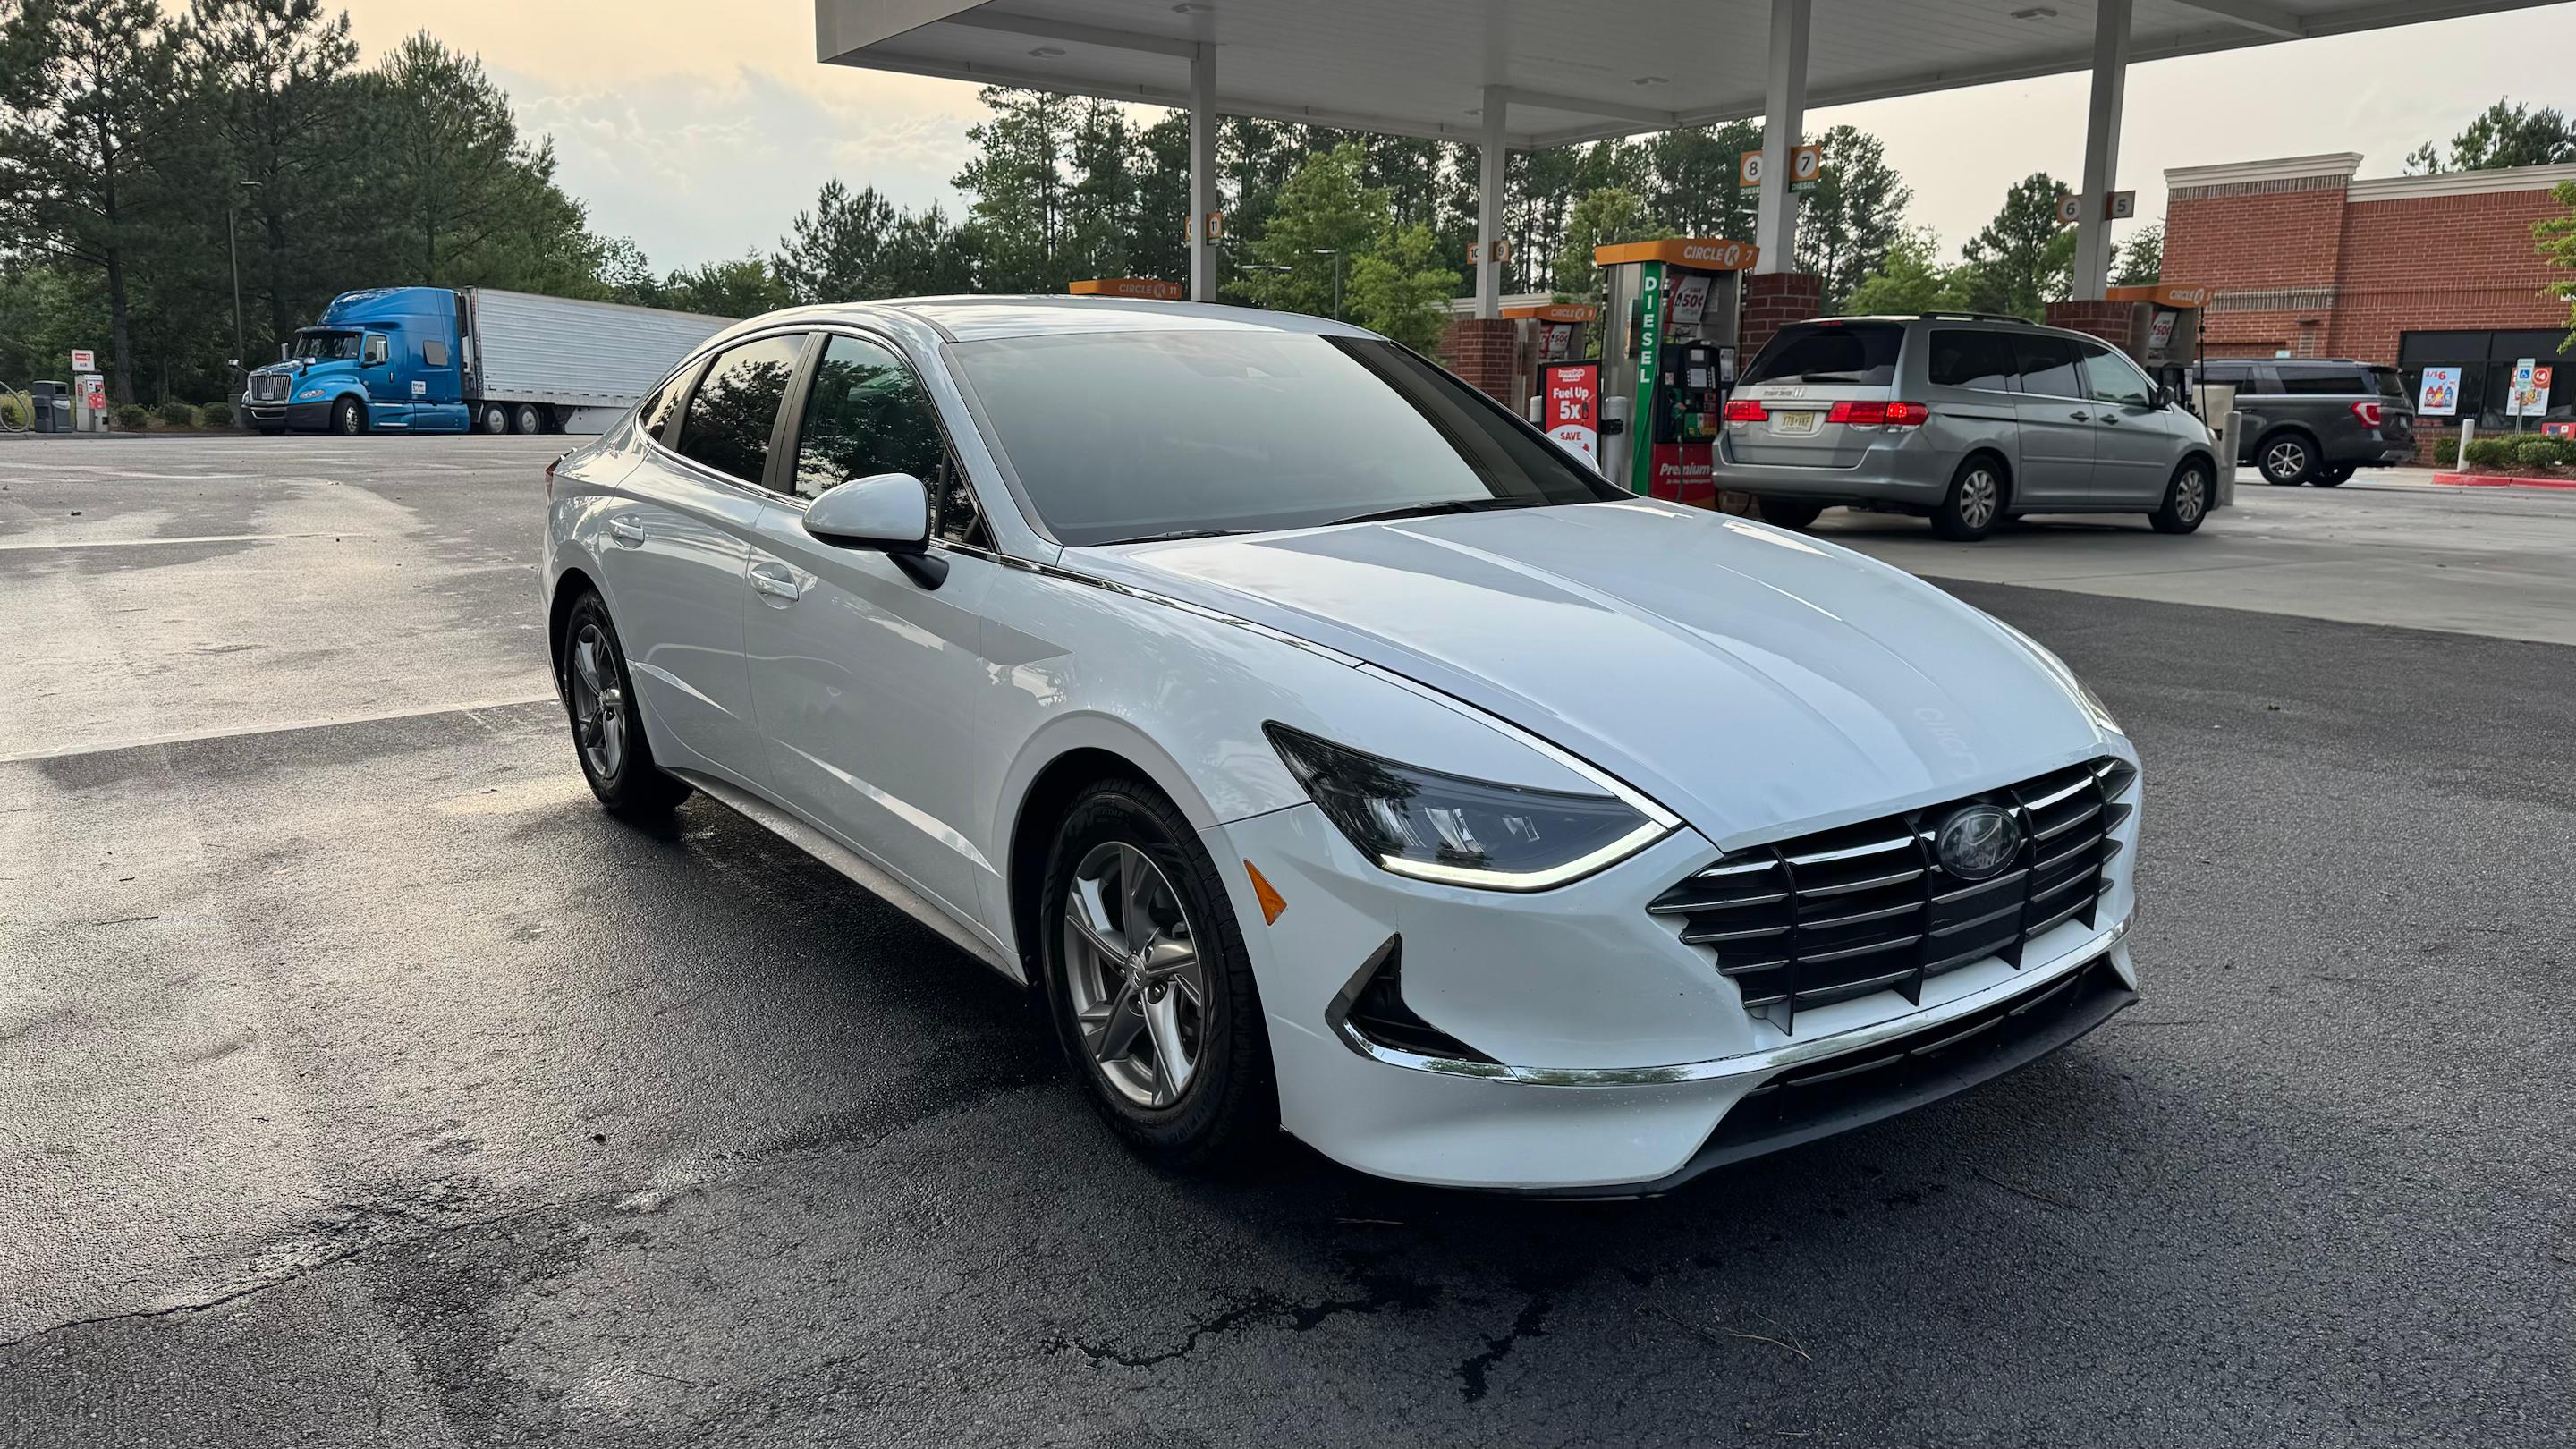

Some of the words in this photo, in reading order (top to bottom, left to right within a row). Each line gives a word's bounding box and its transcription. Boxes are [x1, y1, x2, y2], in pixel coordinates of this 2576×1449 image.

[1749, 161, 1758, 176] 8
[1801, 156, 1811, 172] 7
[1741, 187, 1761, 195] DIESE
[1792, 182, 1817, 191] DIESEL
[2066, 202, 2075, 216] 6
[2116, 199, 2126, 213] 5
[1211, 220, 1218, 232] 11
[1683, 245, 1724, 261] CIRCLE
[1724, 244, 1740, 266] K
[1745, 250, 1753, 261] 7
[1118, 284, 1152, 294] CIRCLE
[1169, 285, 1177, 295] 11
[1640, 276, 1657, 383] DIESEL
[1553, 387, 1573, 399] Fuel
[1574, 386, 1589, 401] Up
[1559, 400, 1580, 420] 5x
[1560, 431, 1582, 441] SAVE
